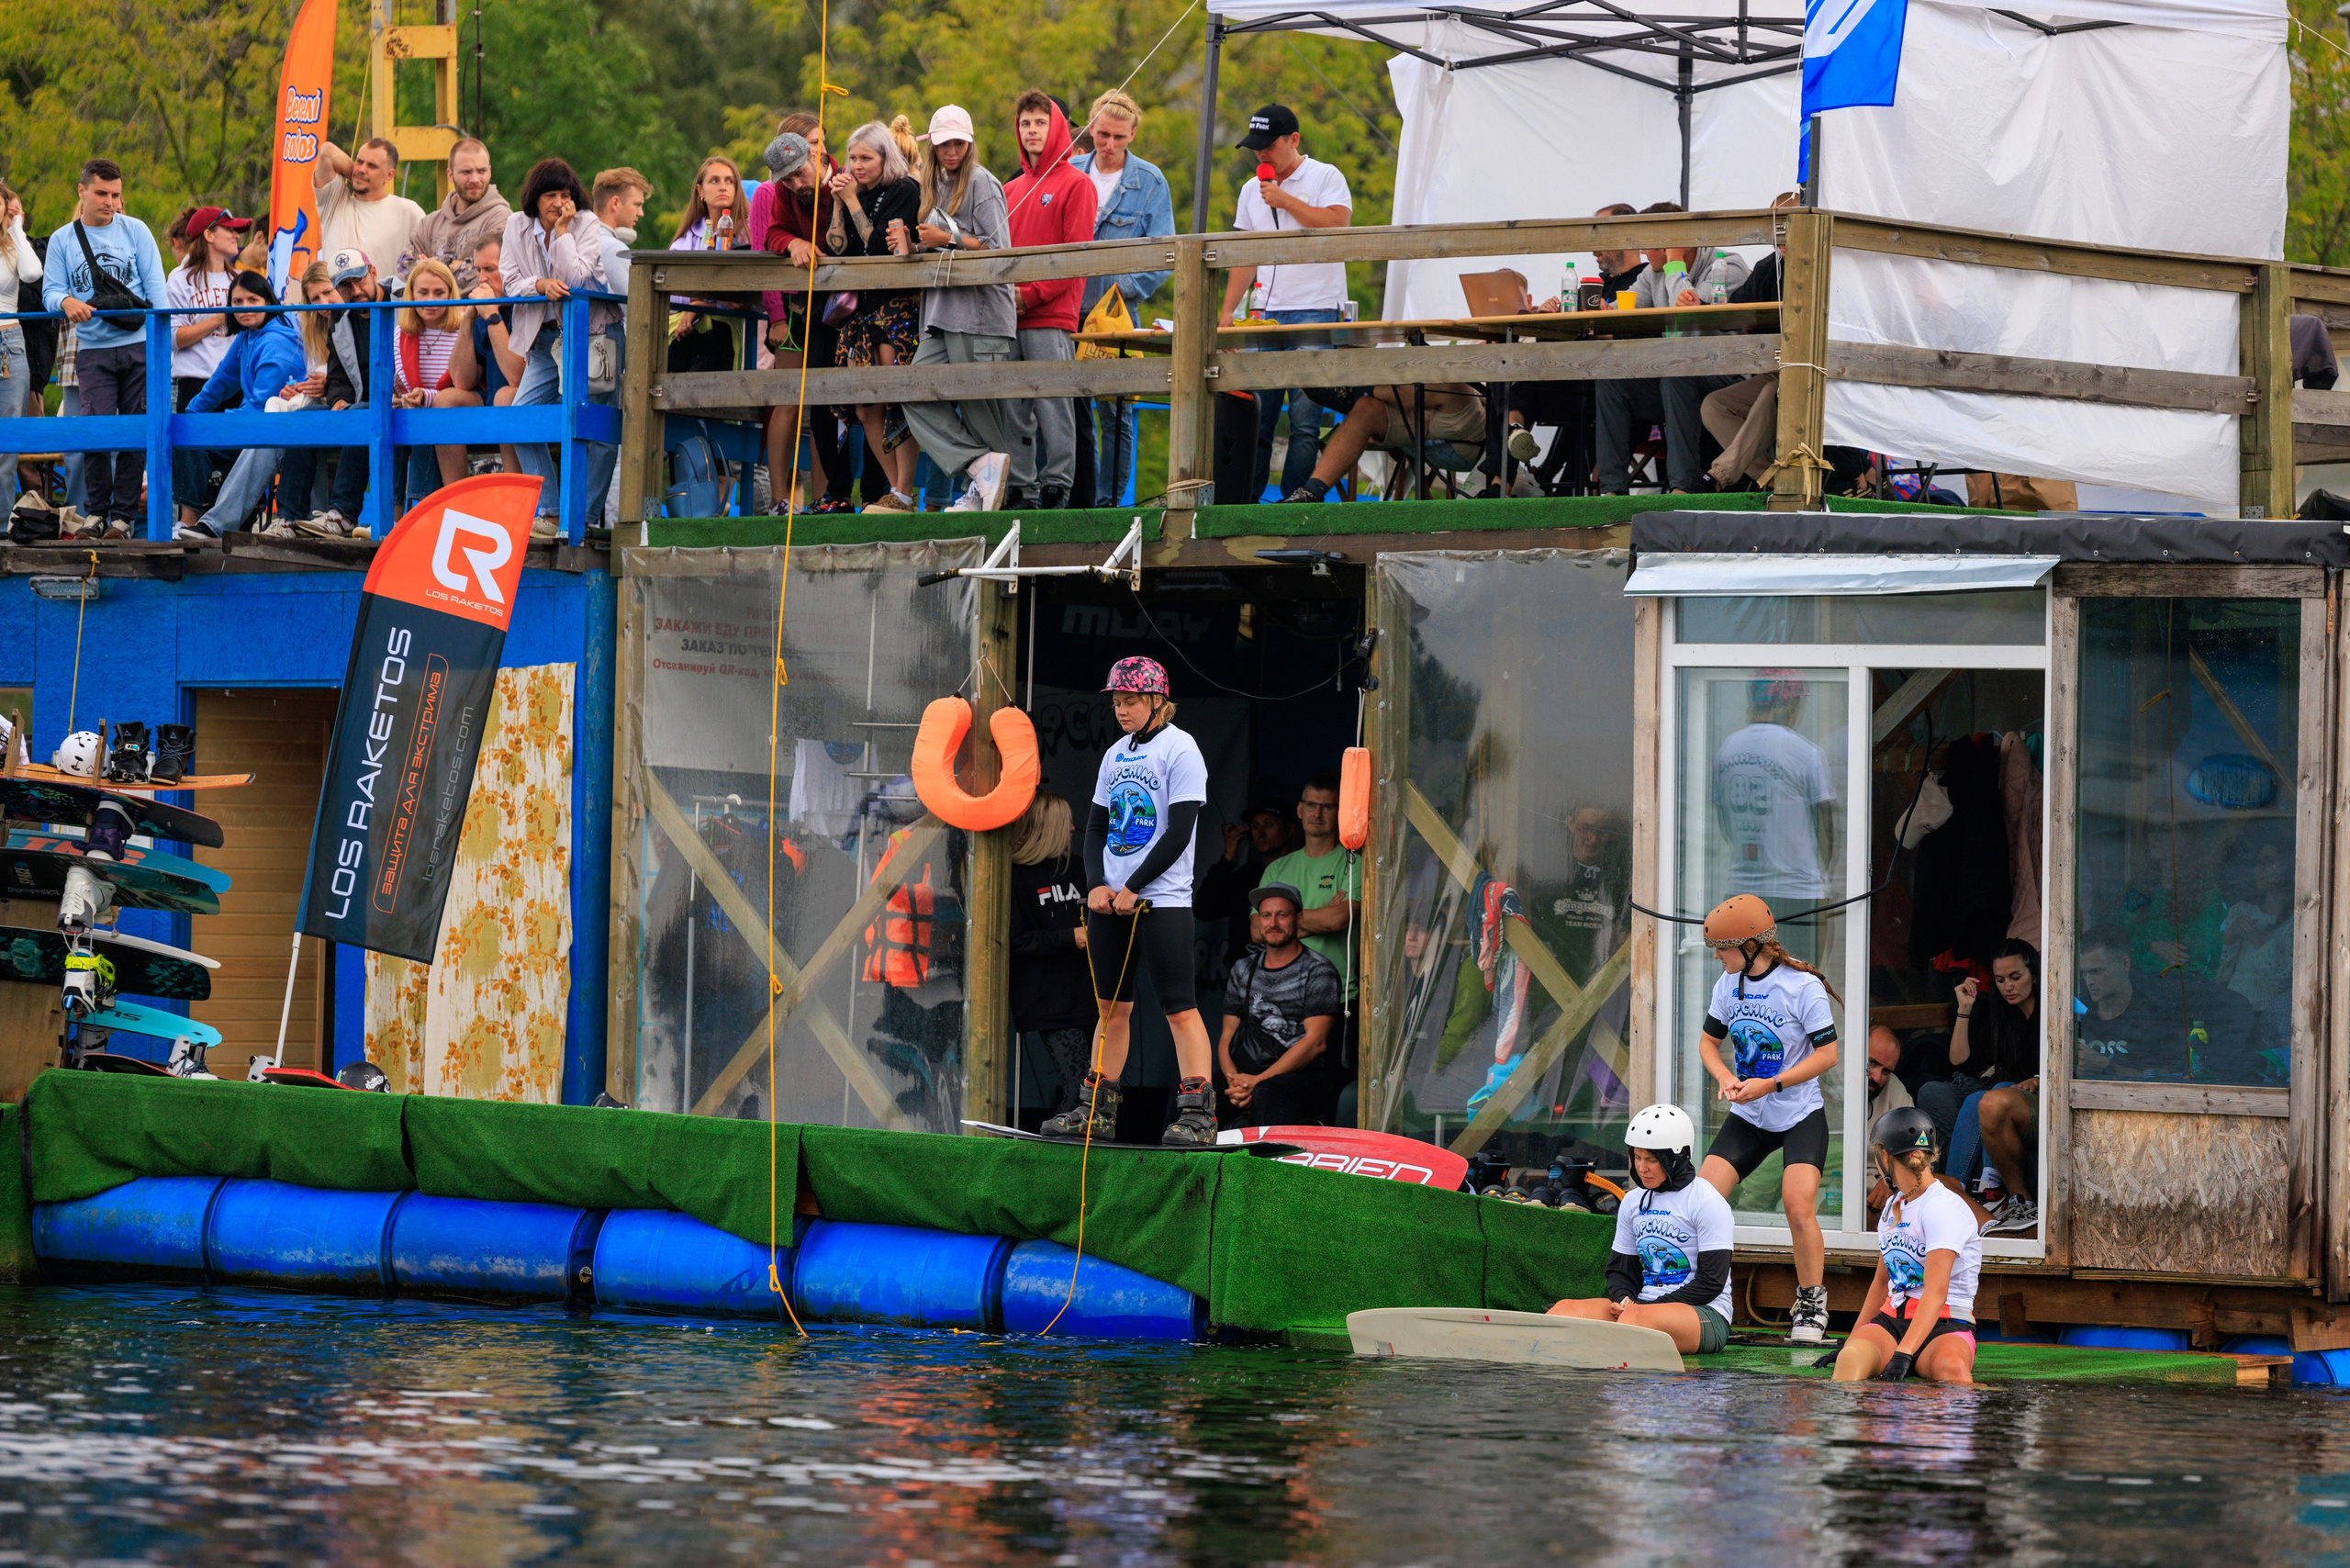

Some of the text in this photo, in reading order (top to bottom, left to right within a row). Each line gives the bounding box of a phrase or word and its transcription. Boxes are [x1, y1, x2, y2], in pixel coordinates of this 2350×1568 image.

[425, 588, 504, 617] LOS RAKETOS
[680, 638, 725, 655] ЗАКАЗ
[653, 657, 716, 677] Отсканируй
[325, 627, 411, 919] LOS RAKETOS
[421, 705, 474, 882] losraketos.com
[1135, 818, 1154, 827] PARK
[1036, 882, 1081, 906] FILA
[1726, 1002, 1787, 1028] UPCHINO
[1762, 1053, 1783, 1061] PARK
[1270, 1152, 1434, 1185] BRIEN
[1634, 1217, 1691, 1243] UPCHINO
[1879, 1231, 1927, 1258] UPCHINO
